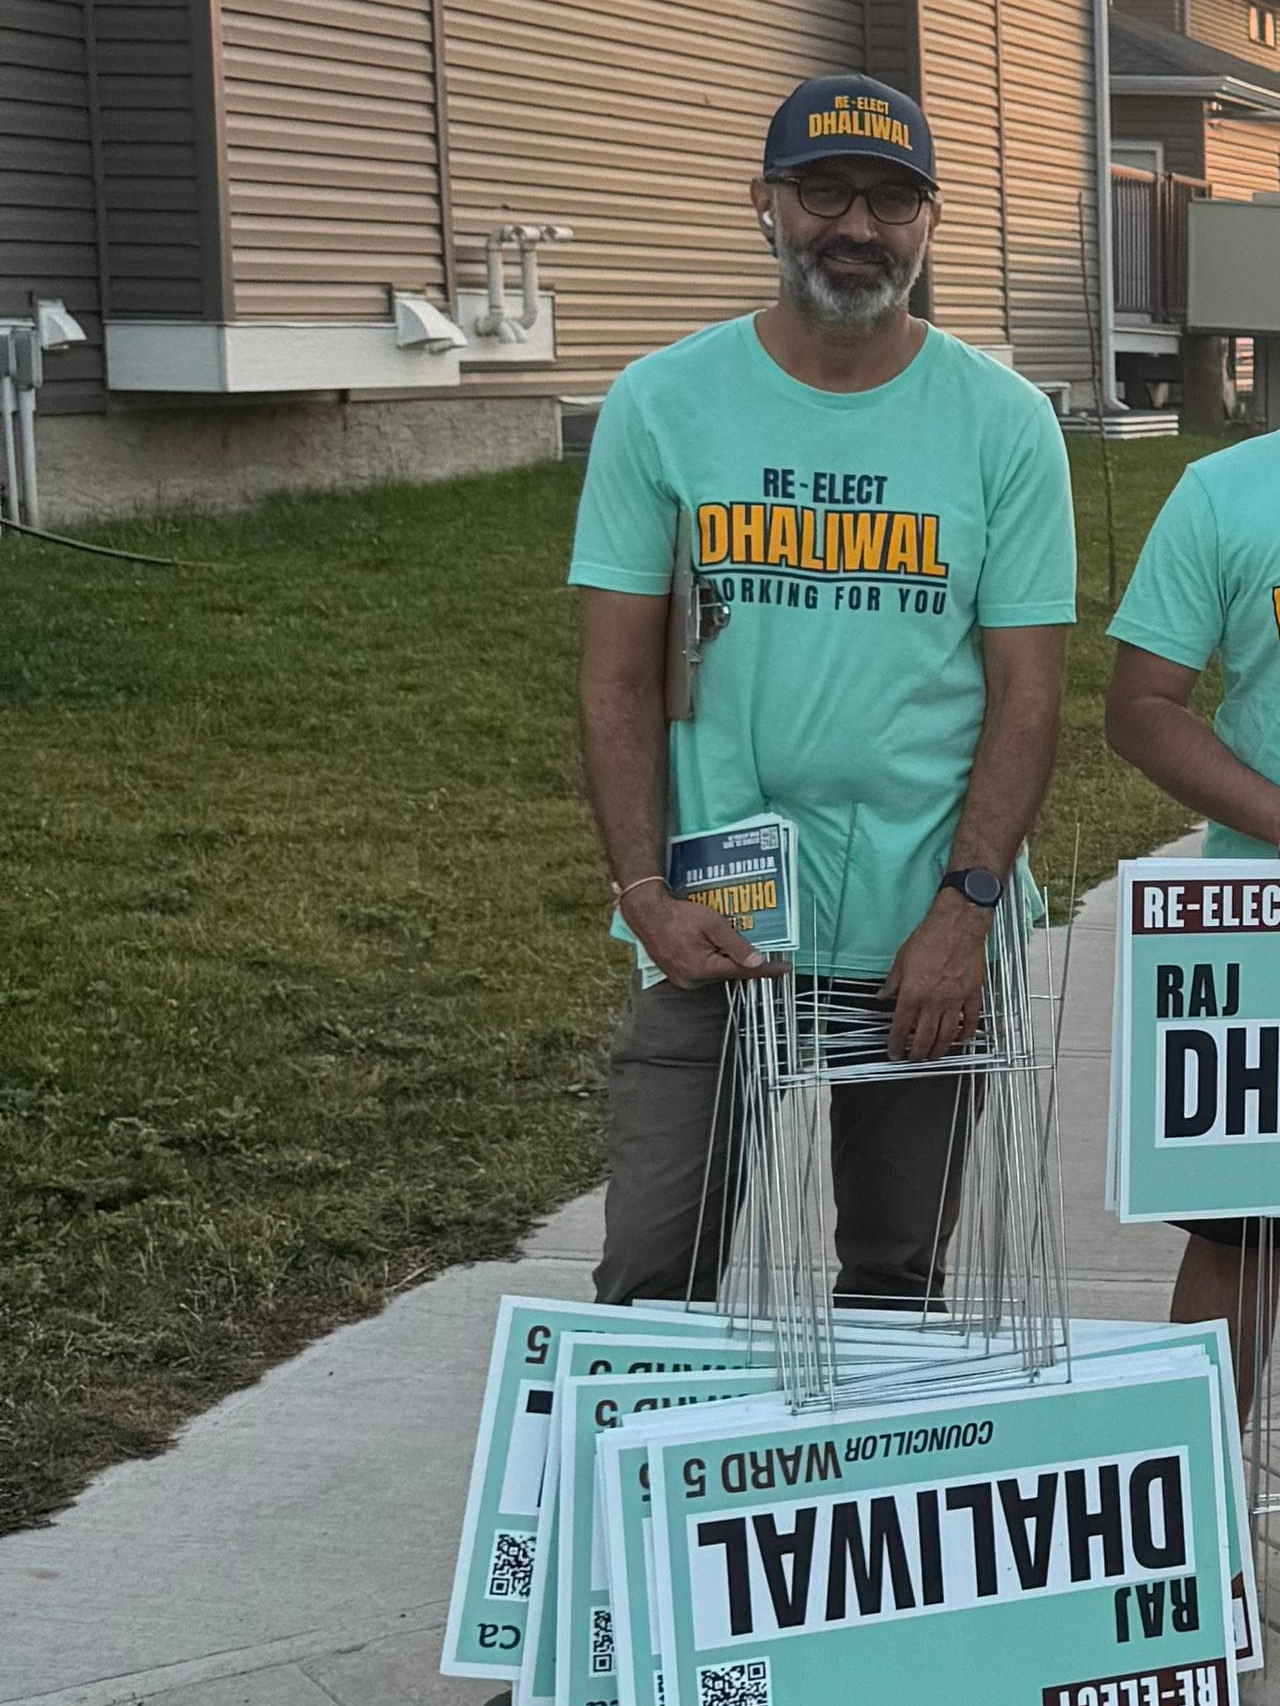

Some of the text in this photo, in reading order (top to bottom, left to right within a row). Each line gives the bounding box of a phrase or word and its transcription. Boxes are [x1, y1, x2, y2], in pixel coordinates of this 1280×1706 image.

[808, 110, 913, 151] DHALIWAL
[763, 467, 888, 505] RE-ELECT
[697, 501, 950, 580] DHALIWAL
[834, 585, 881, 611] FOR
[898, 588, 947, 616] YOU
[1156, 962, 1240, 1018] RAJ
[525, 1325, 551, 1364] 5
[844, 1420, 994, 1462] COUNCILLOR
[683, 1458, 706, 1499] 5
[721, 1441, 843, 1493] WARD
[696, 1455, 1187, 1637] DHALIWAL
[1114, 1576, 1200, 1644] RAJ
